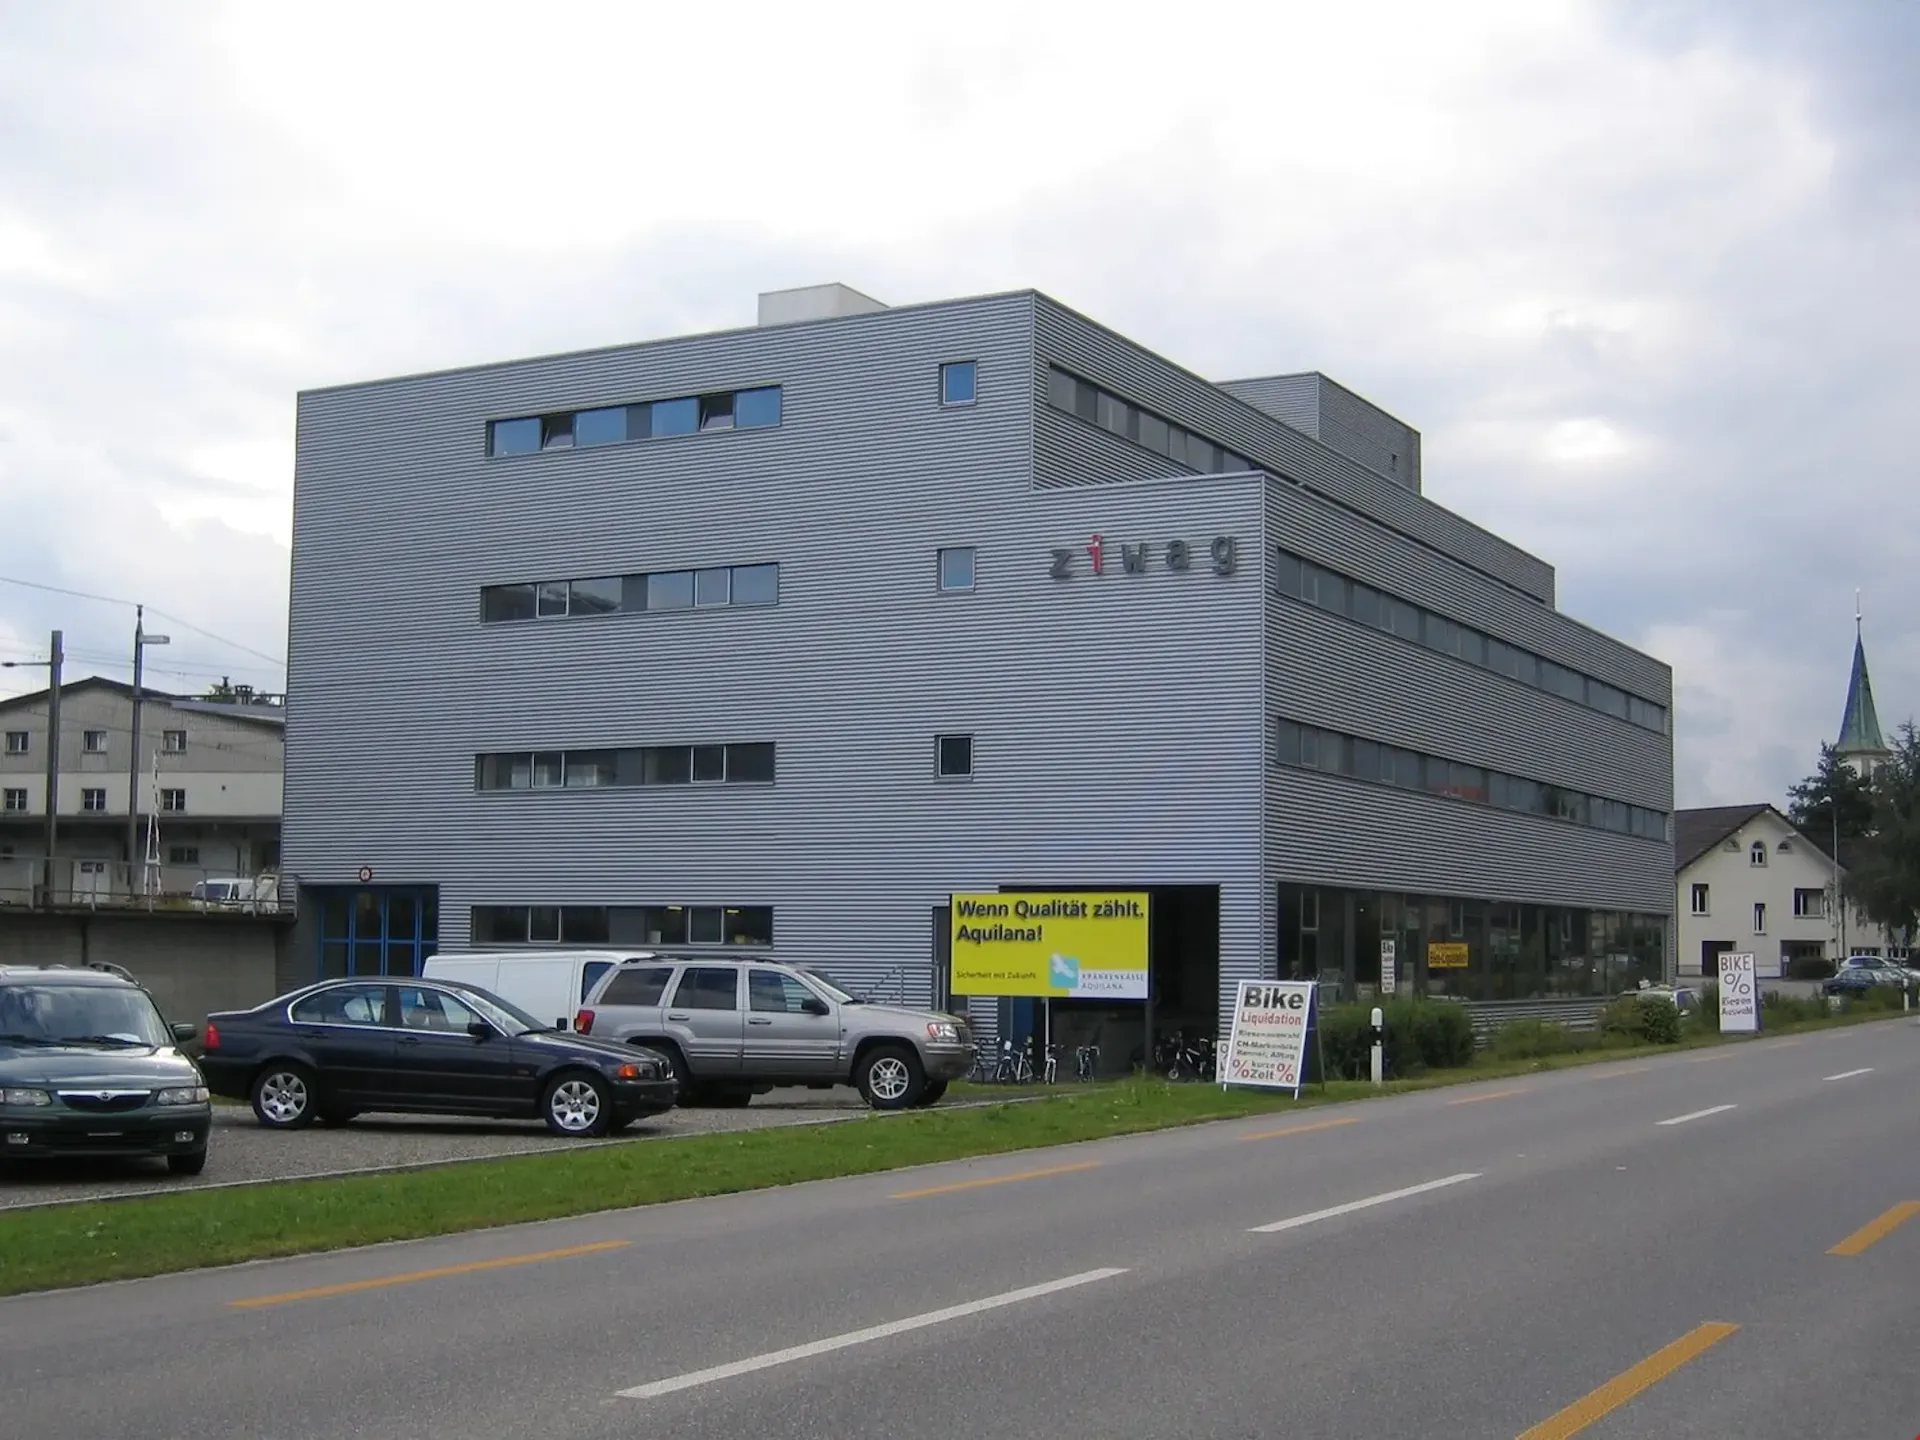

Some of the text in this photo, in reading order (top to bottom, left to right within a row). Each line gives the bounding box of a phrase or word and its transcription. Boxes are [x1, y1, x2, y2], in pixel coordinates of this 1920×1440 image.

[1049, 535, 1238, 578] ziwag
[958, 900, 1145, 922] Wenn Qualität zählt.
[956, 924, 1043, 945] Aquilana!
[1720, 955, 1752, 971] BIKE
[1243, 986, 1304, 1010] Bike
[1241, 1012, 1302, 1027] Liquidation
